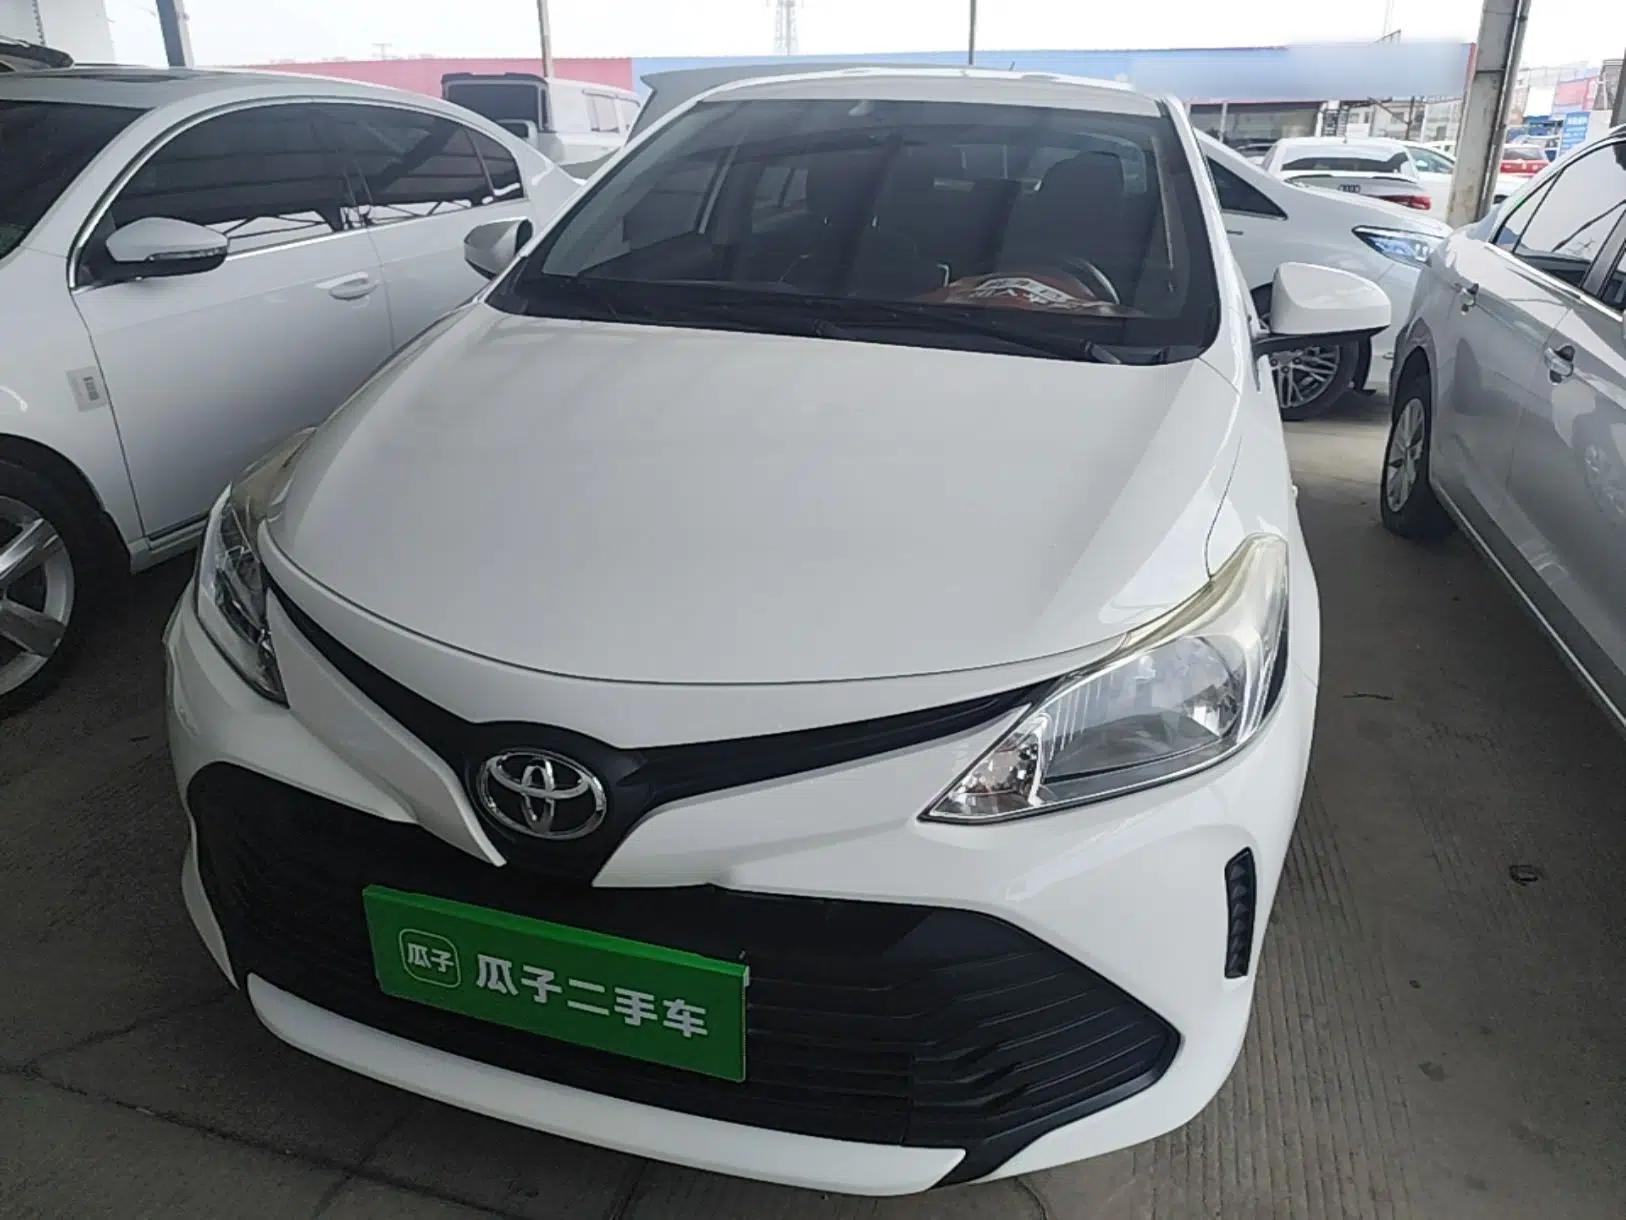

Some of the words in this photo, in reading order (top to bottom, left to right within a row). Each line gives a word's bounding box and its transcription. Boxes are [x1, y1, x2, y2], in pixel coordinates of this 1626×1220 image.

[407, 942, 454, 972] 瓜子
[476, 954, 708, 1038] 瓜子二手车
